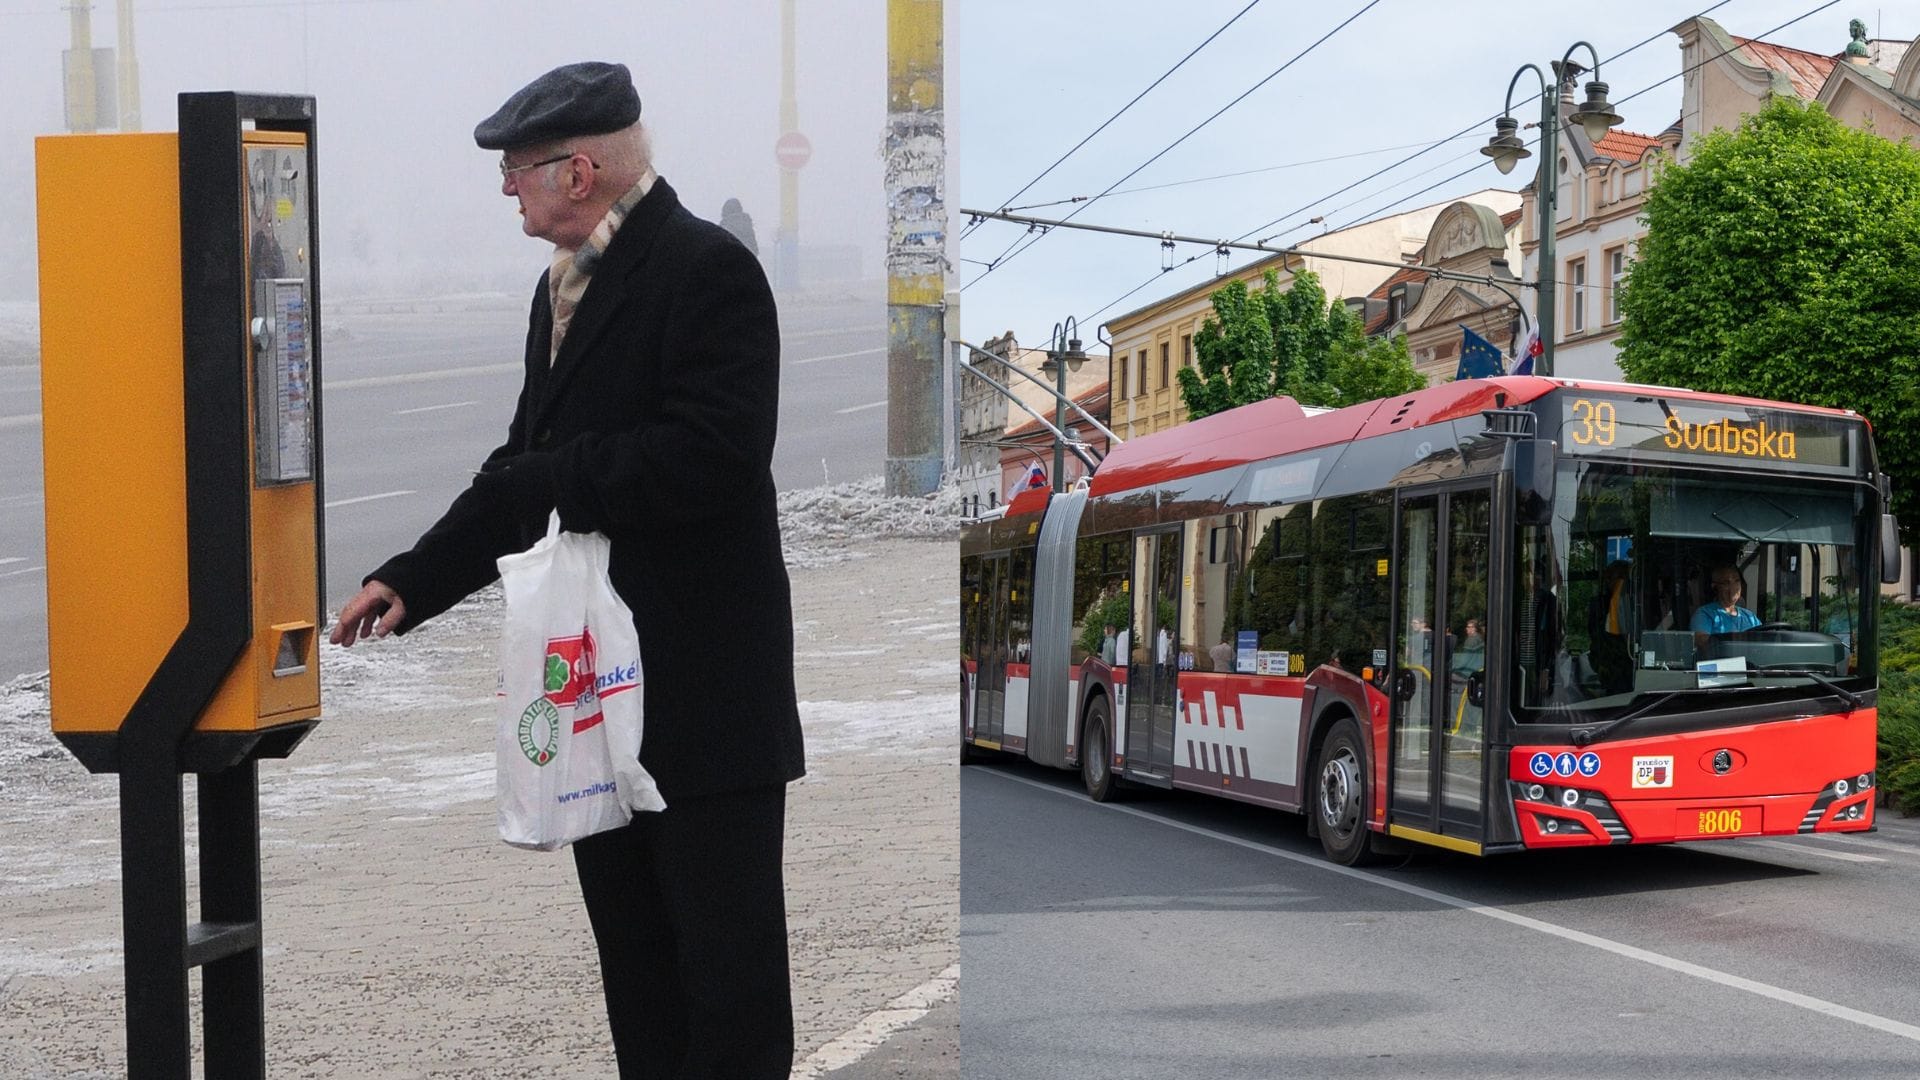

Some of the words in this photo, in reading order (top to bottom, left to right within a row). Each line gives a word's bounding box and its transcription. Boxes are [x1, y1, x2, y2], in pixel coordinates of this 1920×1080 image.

[1572, 400, 1617, 446] 39
[1636, 758, 1670, 766] PREŠOV
[1639, 767, 1653, 777] DP
[1705, 809, 1742, 833] 806
